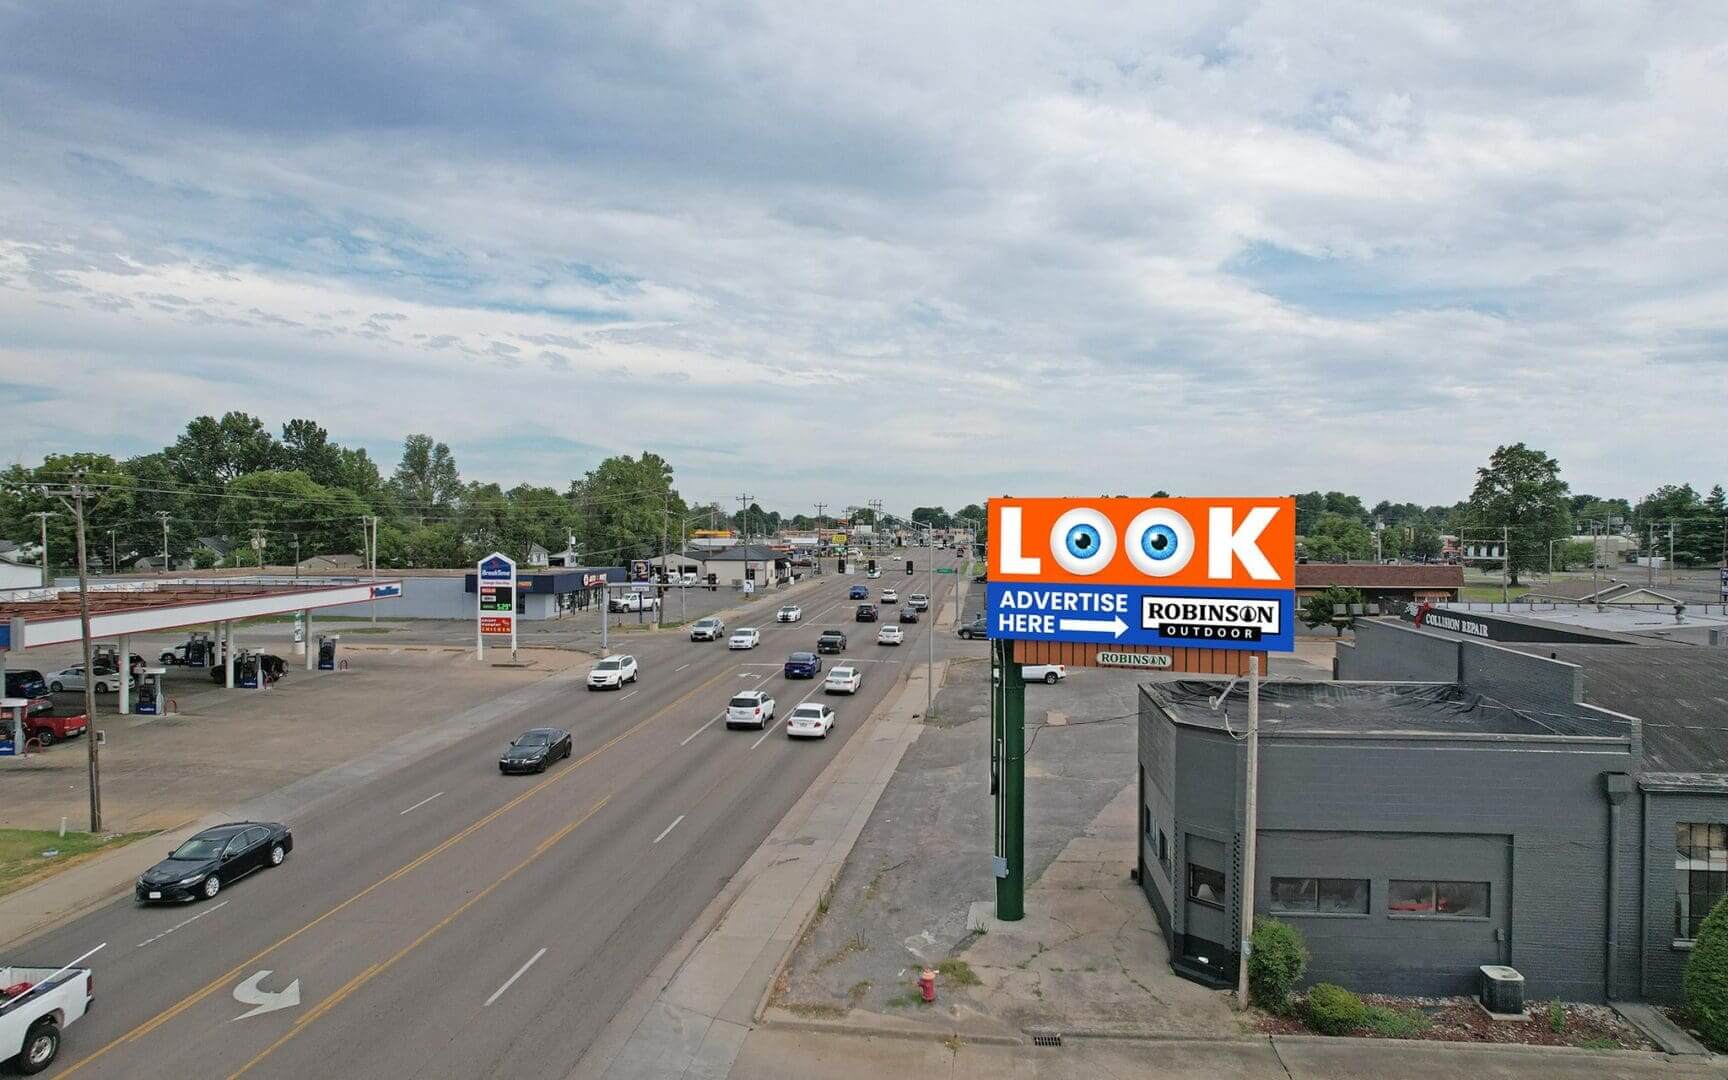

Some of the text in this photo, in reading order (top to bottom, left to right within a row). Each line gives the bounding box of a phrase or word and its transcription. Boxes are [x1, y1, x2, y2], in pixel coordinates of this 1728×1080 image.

[1000, 507, 1281, 580] LOOK
[1000, 590, 1128, 612] ADVERTISE
[999, 613, 1055, 633] HERE
[1148, 603, 1274, 624] ROBINSON
[1167, 625, 1253, 639] OUTDOOR
[1426, 613, 1489, 637] COLLISION REPAIR
[1101, 653, 1167, 666] ROBINSON
